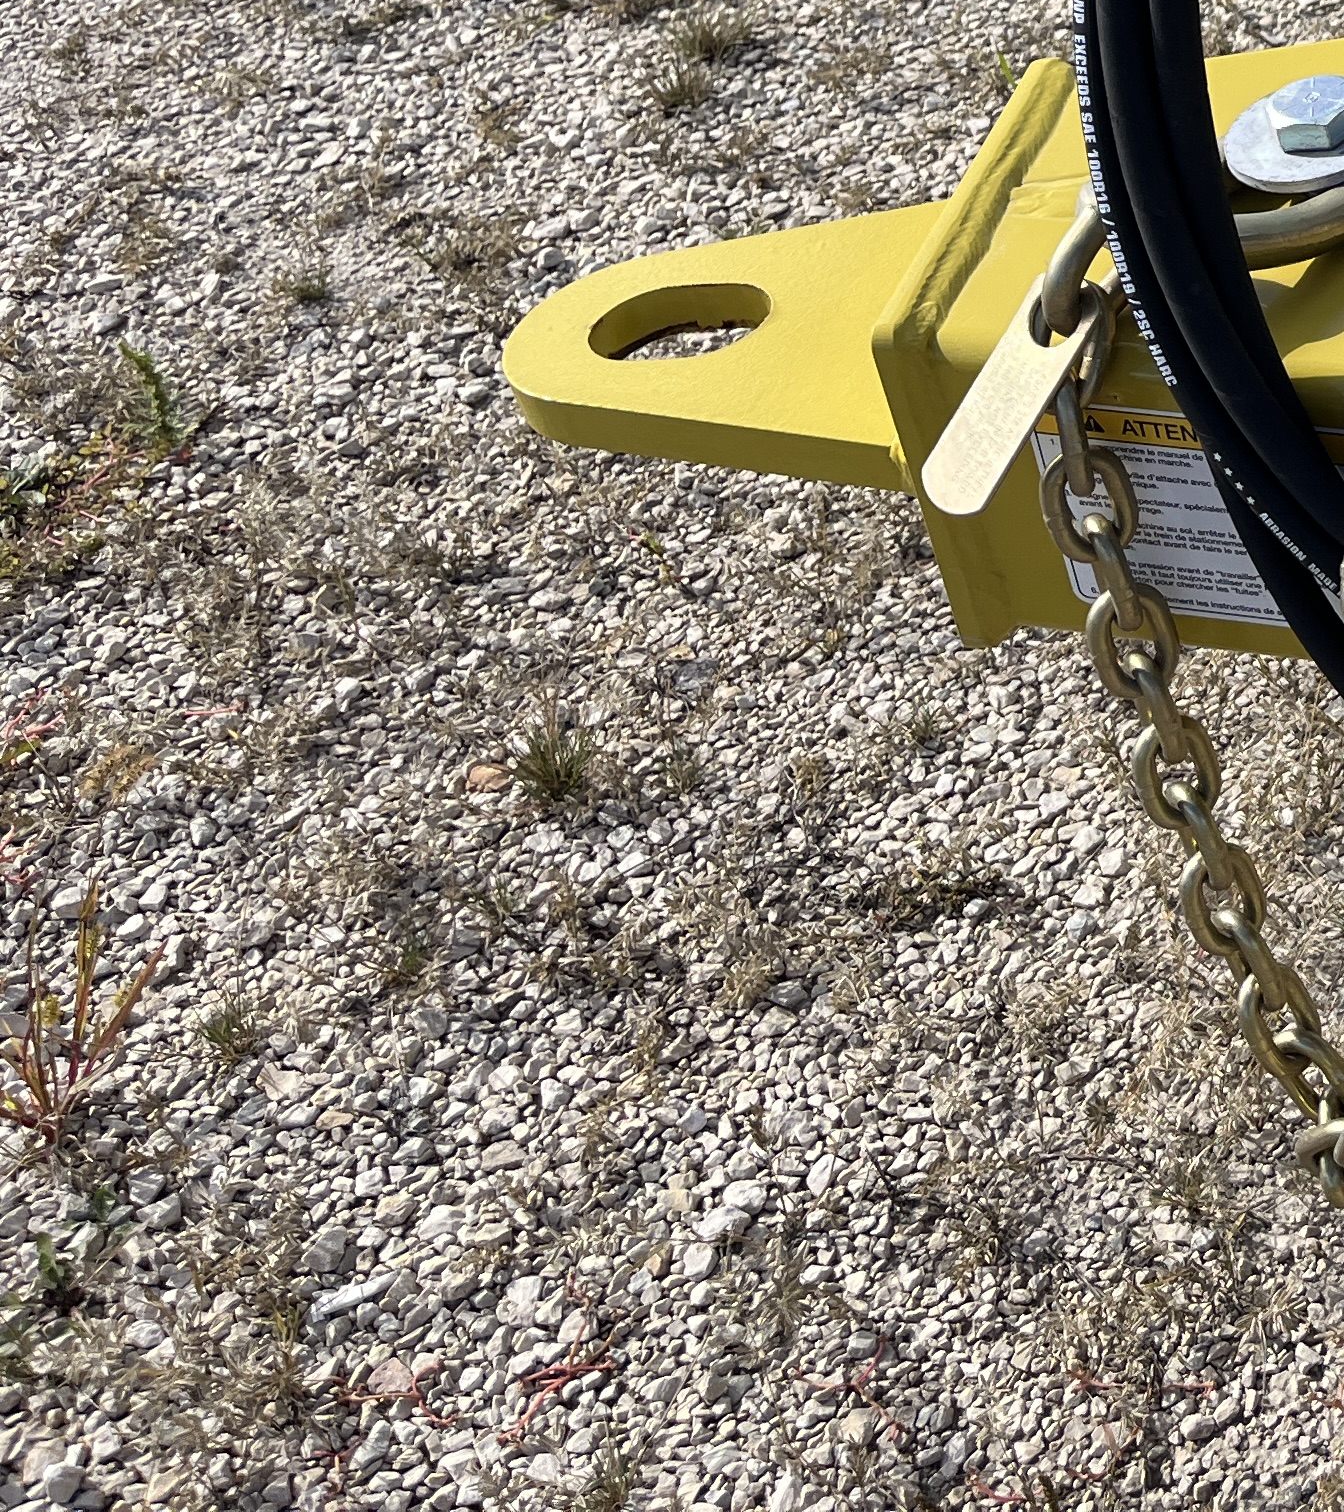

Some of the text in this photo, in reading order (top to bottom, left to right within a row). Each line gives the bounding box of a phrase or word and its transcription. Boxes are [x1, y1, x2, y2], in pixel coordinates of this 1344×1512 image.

[1074, 35, 1092, 108] EXCEEDS
[1081, 112, 1097, 145] SAE
[1087, 149, 1111, 216] 100R16
[1106, 230, 1137, 295] 100R19
[1132, 308, 1155, 341] 2SC
[1121, 419, 1199, 443] ATTEN
[1259, 512, 1307, 561] ABRASION
[1307, 562, 1338, 591] MADE
